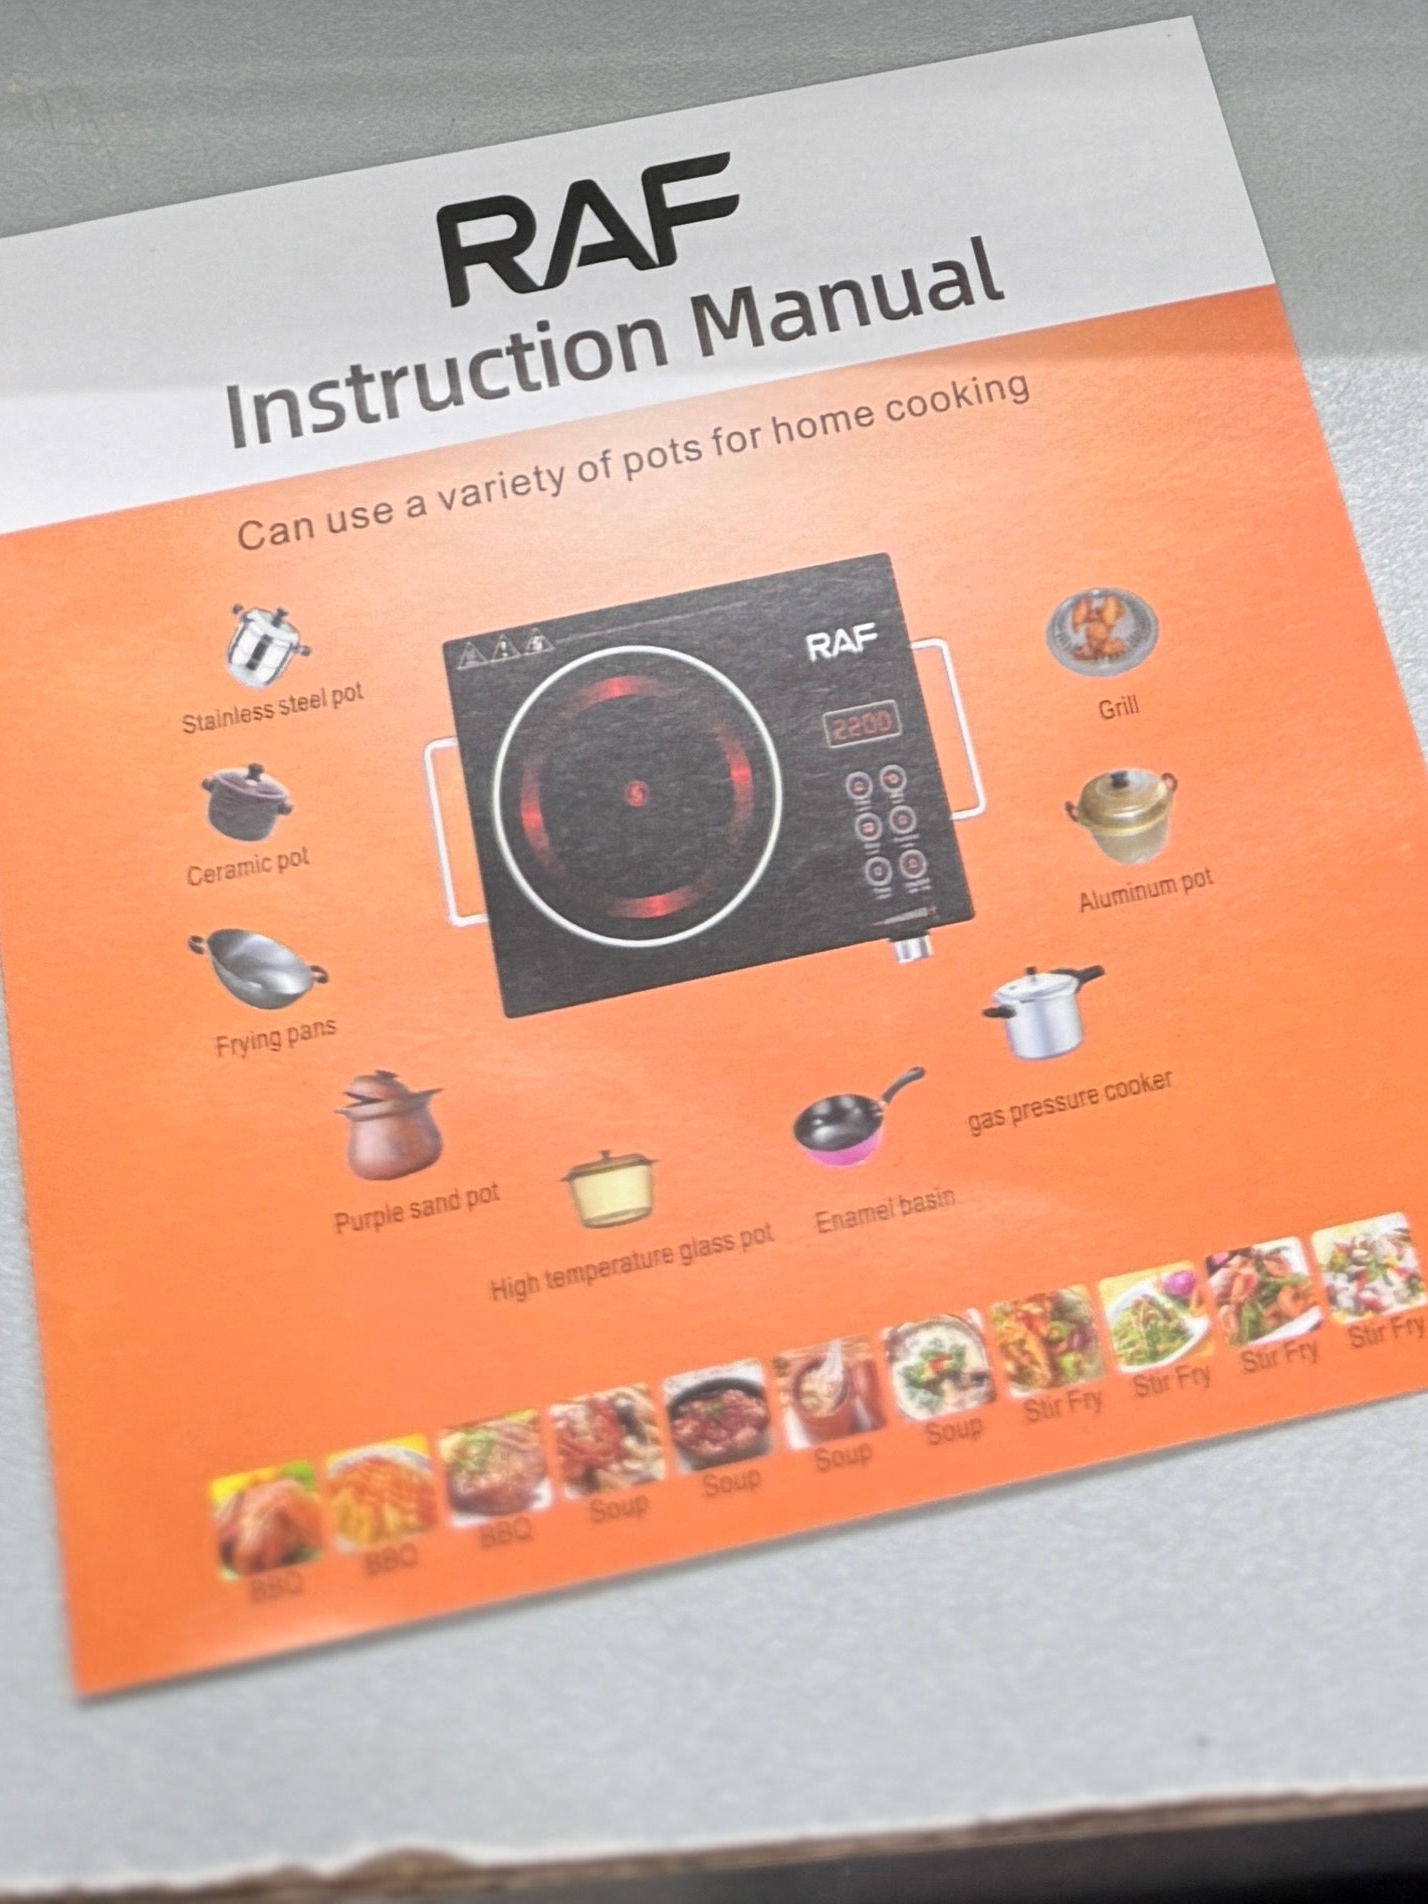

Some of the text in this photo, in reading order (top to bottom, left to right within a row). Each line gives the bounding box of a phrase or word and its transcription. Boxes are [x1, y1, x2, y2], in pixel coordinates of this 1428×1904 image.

[437, 151, 740, 307] RAF
[226, 236, 1006, 449] Instruction Manual
[238, 374, 1030, 551] Can use a variety of pots for home cooking
[805, 622, 878, 662] RAF
[182, 681, 365, 735] Stainless steel pot
[832, 709, 893, 740] 2200
[1098, 694, 1140, 721] Grill
[186, 846, 311, 887] Ceramic pot
[1079, 866, 1214, 914] Aluminum pot
[216, 1017, 337, 1060] Frying pans
[968, 1069, 1173, 1137] gas pressure cooker
[334, 1181, 500, 1235] Purple sand pot
[815, 1187, 955, 1234] Enamel basin
[490, 1222, 775, 1304] High temperature glass pot
[1349, 1315, 1425, 1349] Stir Fry
[1240, 1339, 1317, 1373] Stir Fry
[1133, 1364, 1211, 1398] Stir Fry
[1024, 1389, 1102, 1423] Stir Fry
[926, 1417, 983, 1445] Soup
[815, 1443, 871, 1471] Soup
[703, 1468, 761, 1497] Soup
[590, 1495, 649, 1523] Soup
